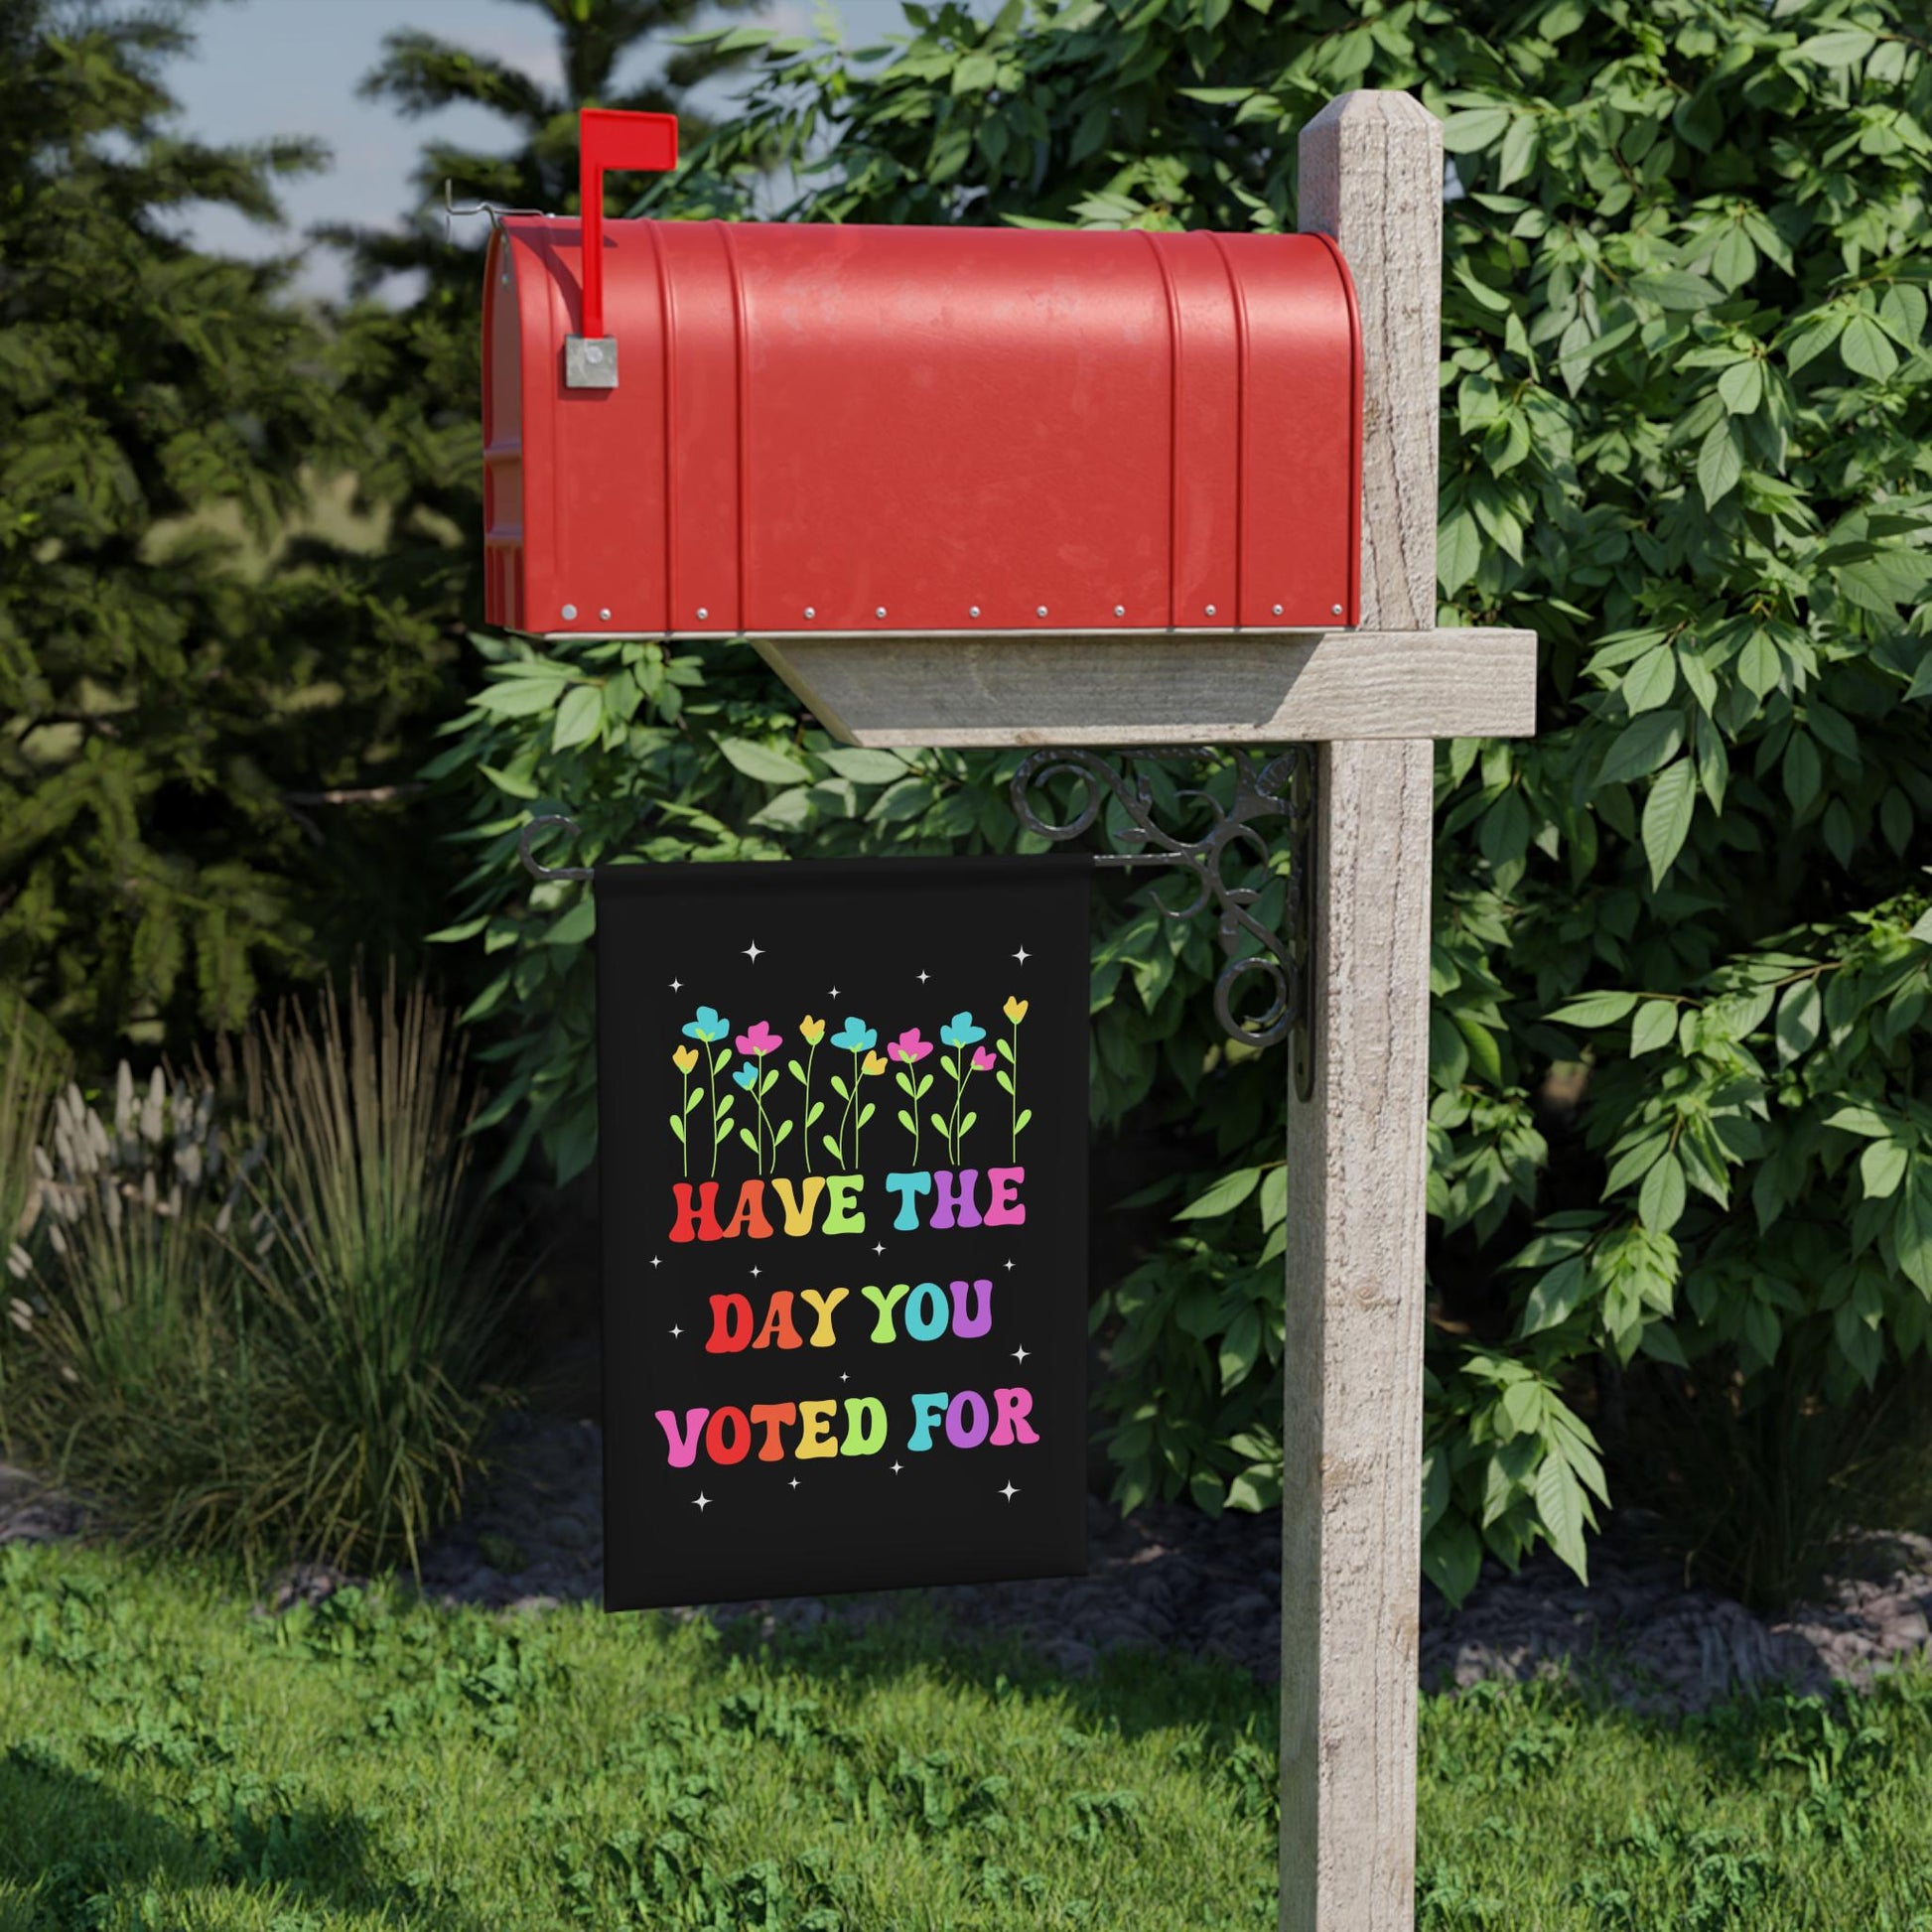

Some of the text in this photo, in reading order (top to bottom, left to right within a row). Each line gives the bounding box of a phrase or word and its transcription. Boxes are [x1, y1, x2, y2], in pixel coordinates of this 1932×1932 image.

[669, 1167, 1027, 1243] HAVE THE
[705, 1280, 993, 1353] DAY YOU
[655, 1387, 1039, 1468] VOTED FOR
